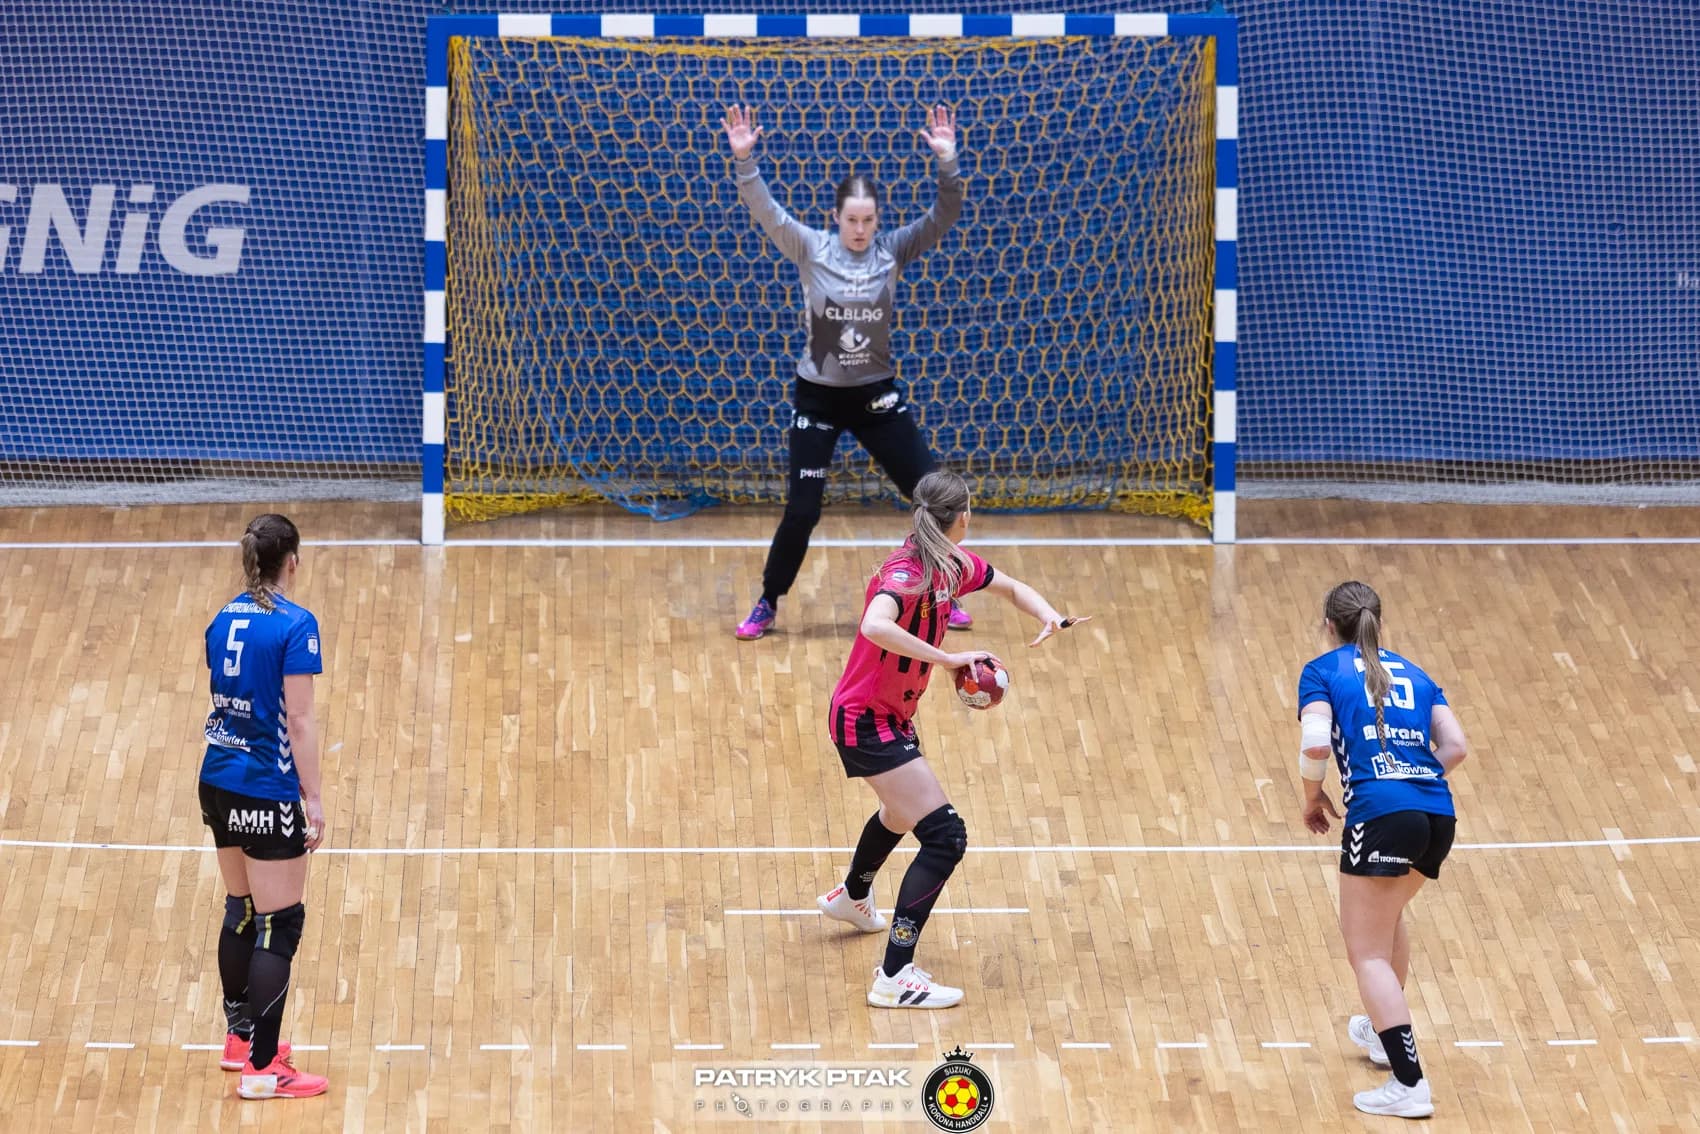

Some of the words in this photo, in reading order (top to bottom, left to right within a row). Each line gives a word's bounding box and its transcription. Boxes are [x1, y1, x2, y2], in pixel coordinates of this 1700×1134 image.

[0, 183, 250, 276] NiG
[223, 619, 250, 677] 5
[228, 809, 274, 827] AMH
